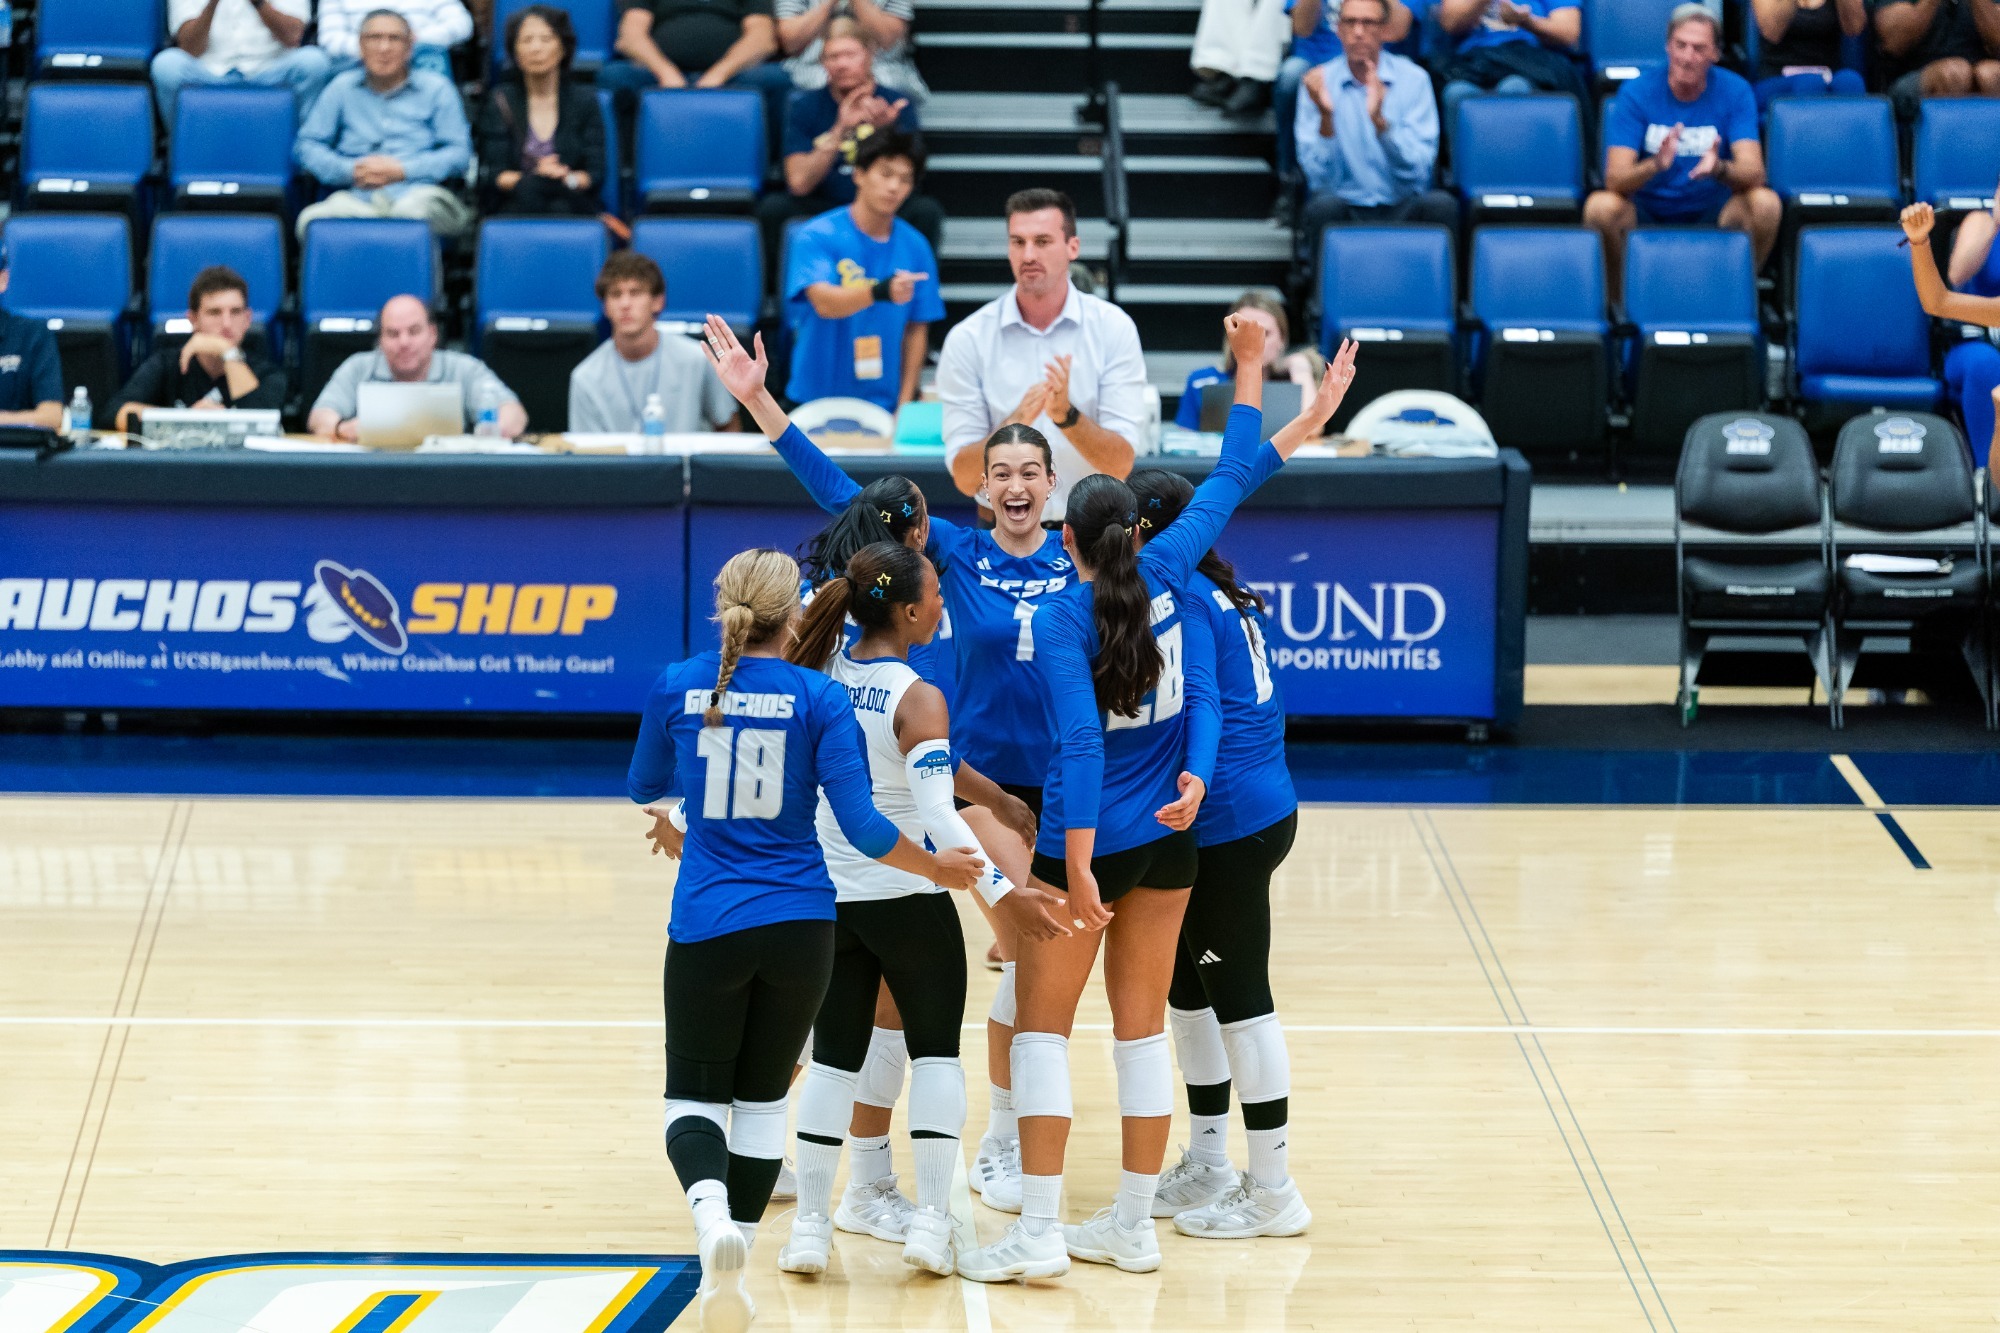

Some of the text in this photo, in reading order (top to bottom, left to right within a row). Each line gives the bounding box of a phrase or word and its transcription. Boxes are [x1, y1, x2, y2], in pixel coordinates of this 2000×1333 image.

[0, 578, 618, 635] AUCHOS SHOP
[1013, 599, 1038, 661] 1
[51, 650, 84, 668] and
[88, 650, 147, 669] Online
[342, 652, 398, 671] Where
[402, 653, 476, 672] Gauchos
[479, 654, 511, 673] Get
[514, 654, 563, 673] Their
[565, 655, 615, 673] Gear!
[1106, 621, 1184, 732] 8
[697, 726, 787, 820] 18
